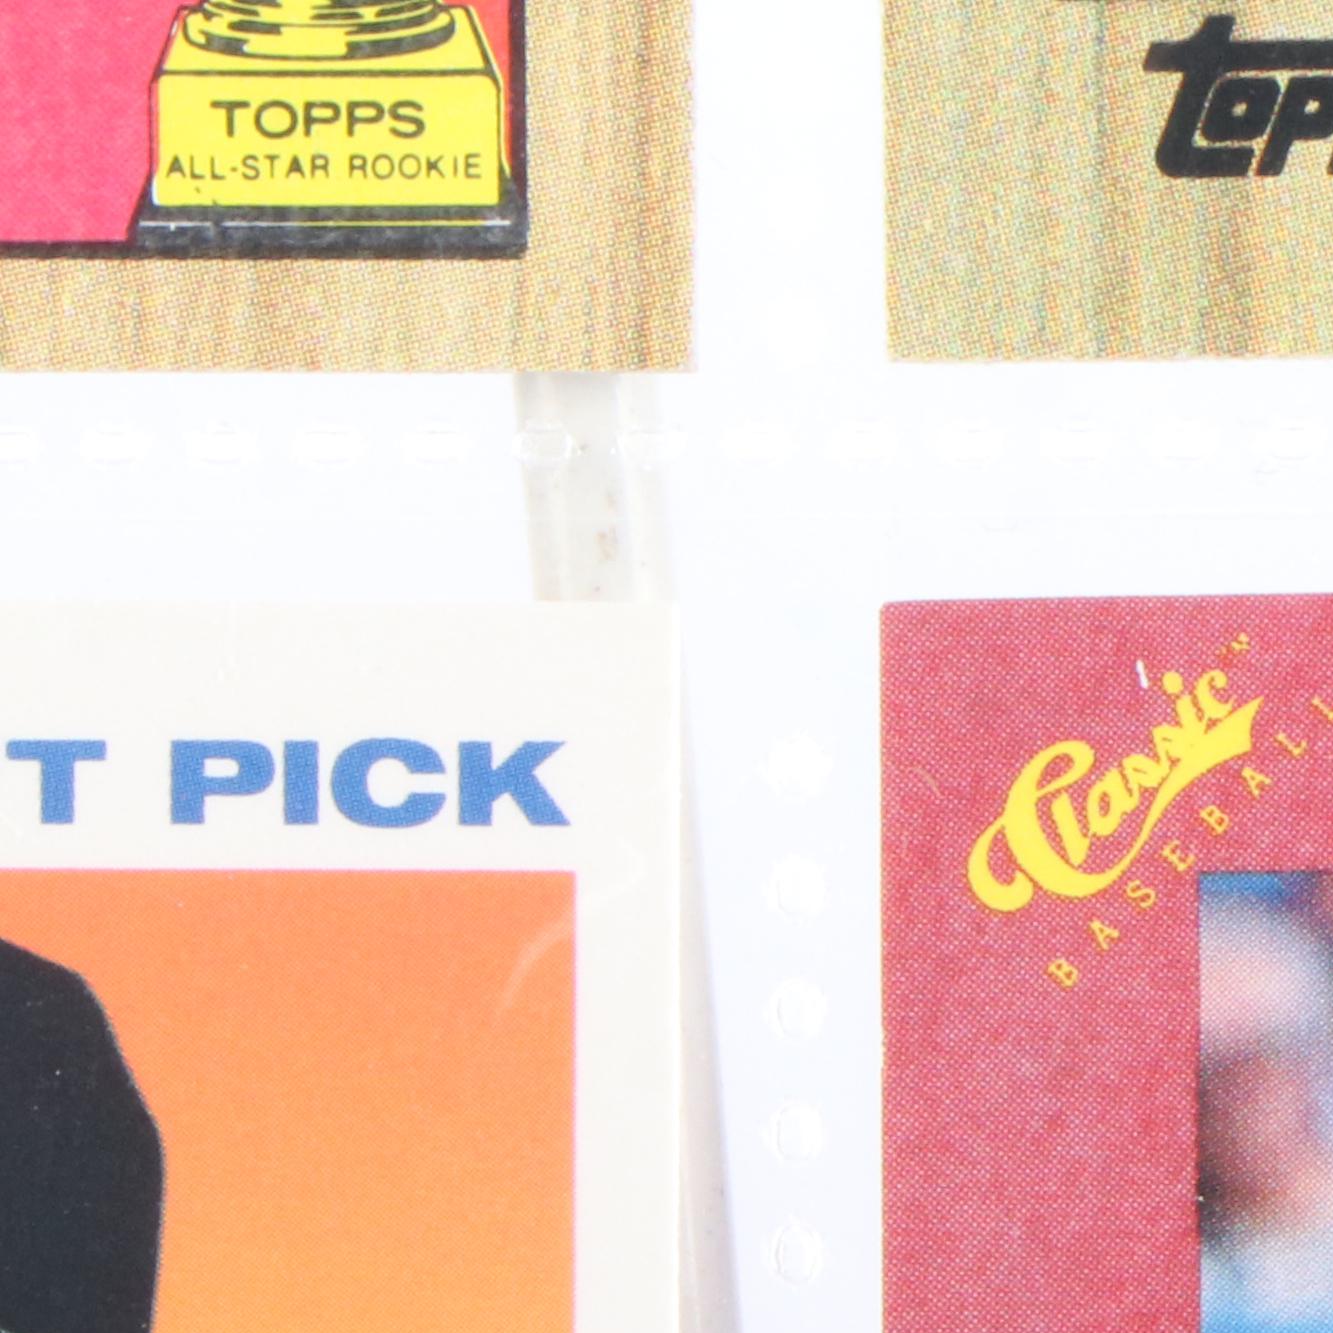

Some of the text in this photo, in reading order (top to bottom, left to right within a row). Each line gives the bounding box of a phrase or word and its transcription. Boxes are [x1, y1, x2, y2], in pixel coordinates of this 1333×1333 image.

[210, 100, 426, 139] TOPPS
[165, 153, 483, 181] ALL-STAR ROOKIE
[169, 737, 572, 829] PICK
